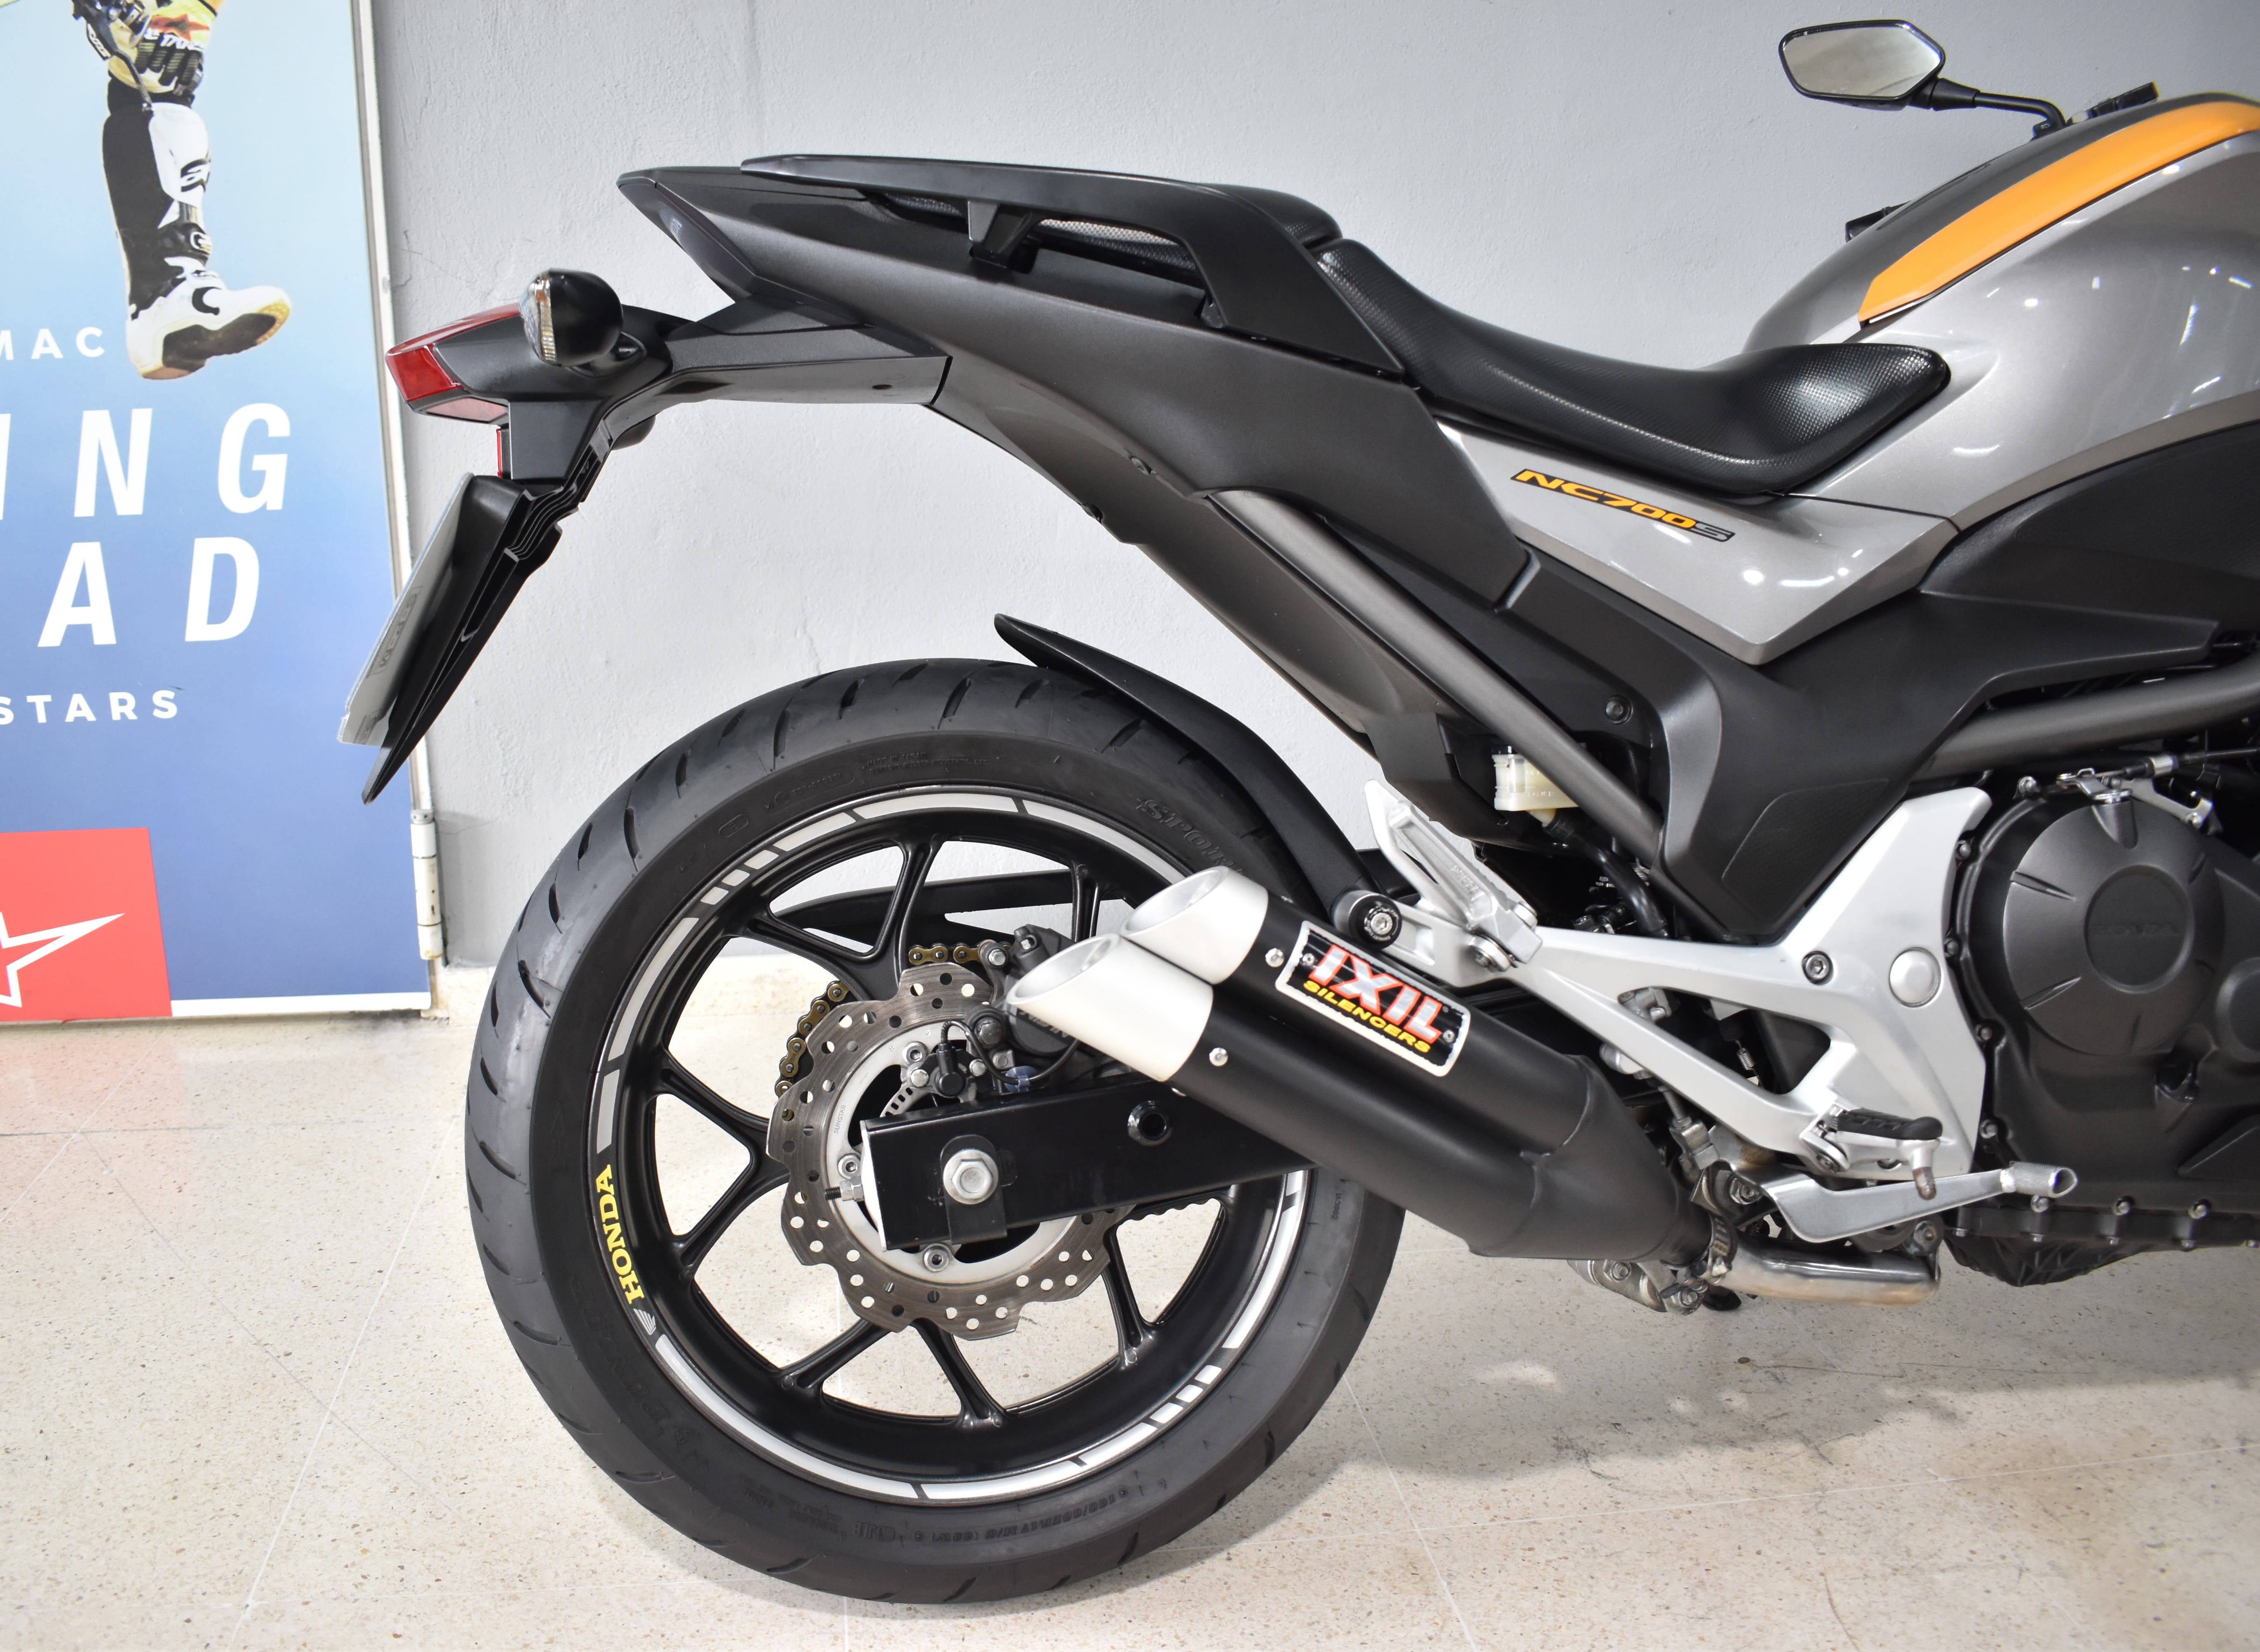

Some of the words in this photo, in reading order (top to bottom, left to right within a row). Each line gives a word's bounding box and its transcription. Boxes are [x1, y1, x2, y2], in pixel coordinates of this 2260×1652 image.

[1515, 469, 1735, 542] NC700S
[38, 537, 260, 647] AD
[1303, 980, 1431, 1053] SILENCERS
[1309, 944, 1443, 1044] IXIL
[834, 1104, 846, 1135] SUNSTAR
[596, 1164, 645, 1304] HONDA
